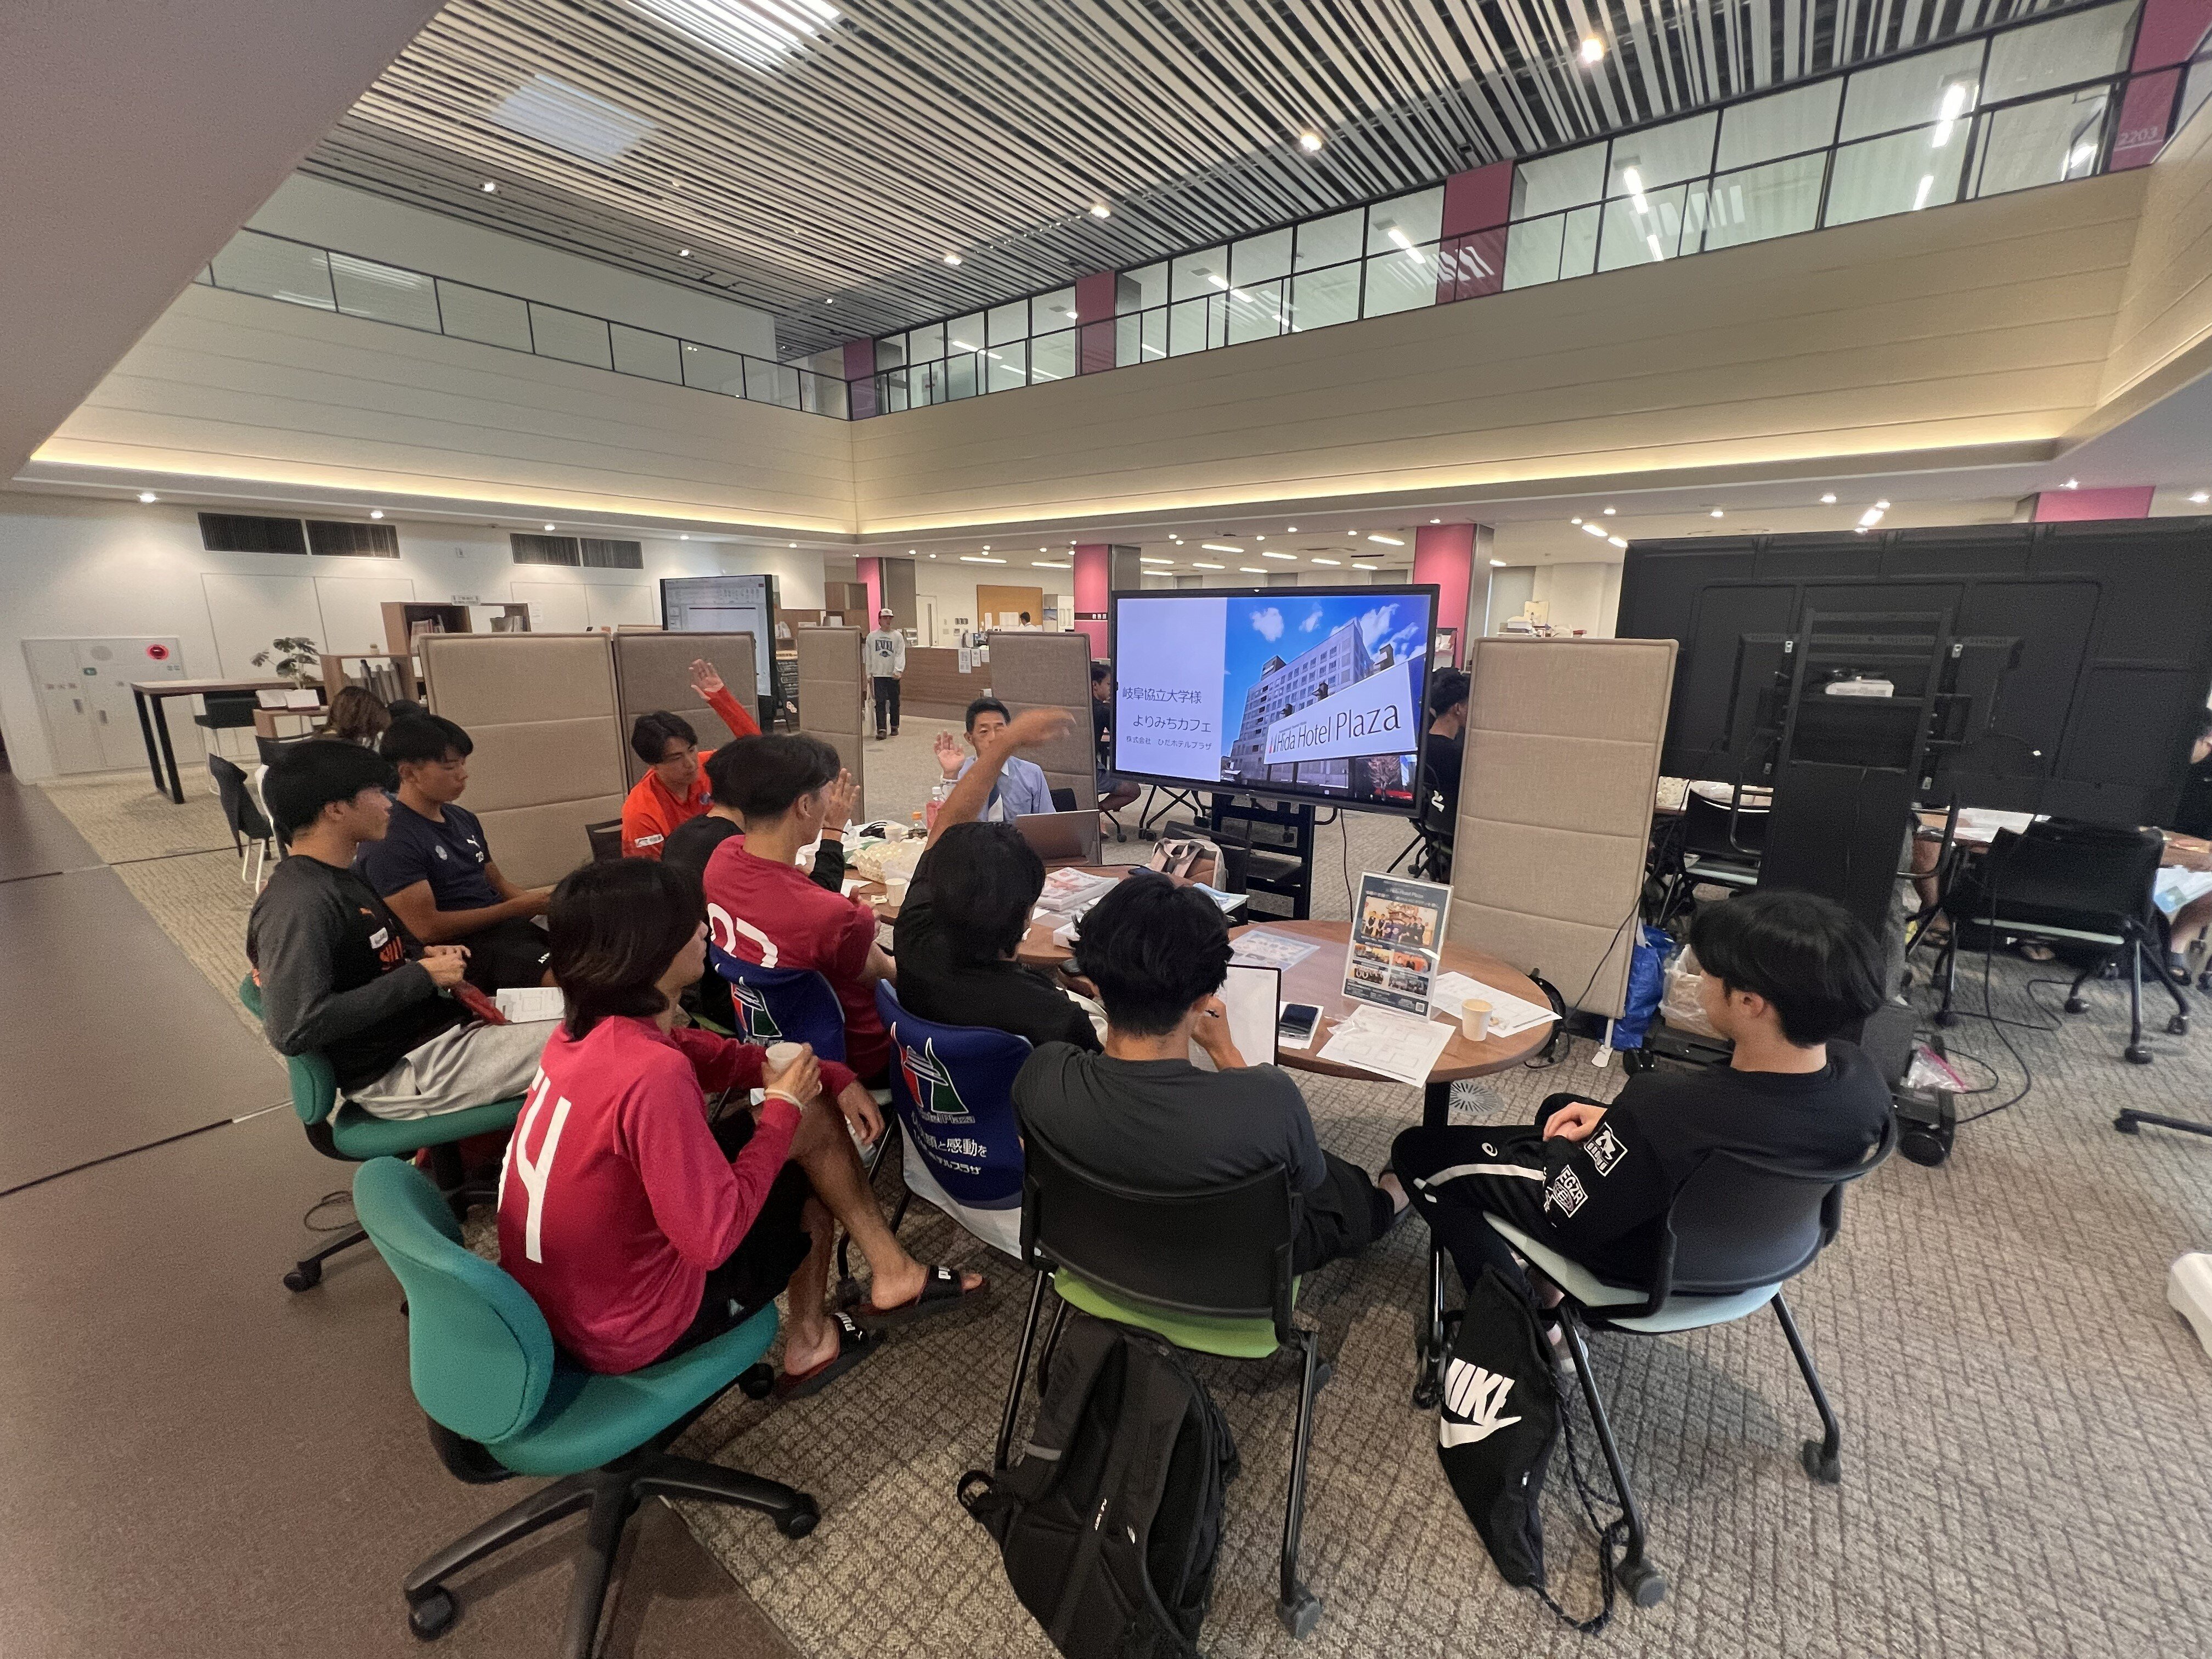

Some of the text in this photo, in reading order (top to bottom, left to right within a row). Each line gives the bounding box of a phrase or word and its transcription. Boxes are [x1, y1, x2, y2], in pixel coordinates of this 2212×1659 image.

[1122, 686, 1202, 704] 岐阜協立大学様
[1133, 714, 1211, 732] よりみちカフェ
[1277, 704, 1401, 752] Hida Hotel Plaza
[1126, 736, 1212, 751] 株式会社 ひだホテルプラザ
